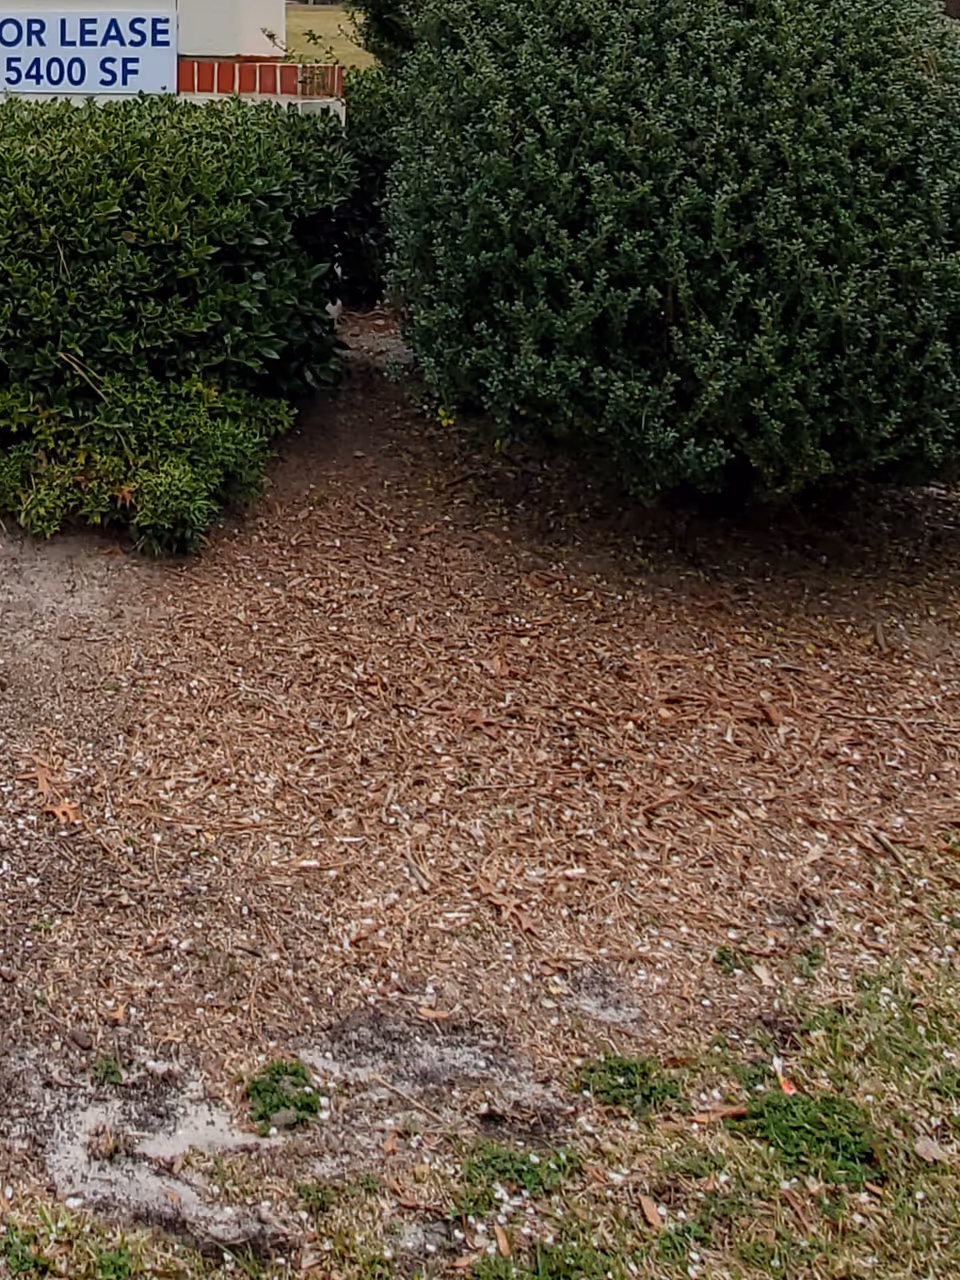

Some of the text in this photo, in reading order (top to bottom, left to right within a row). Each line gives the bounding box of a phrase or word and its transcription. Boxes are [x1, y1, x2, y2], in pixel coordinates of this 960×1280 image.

[59, 17, 171, 48] LEASE
[5, 57, 141, 86] 5400 SF
